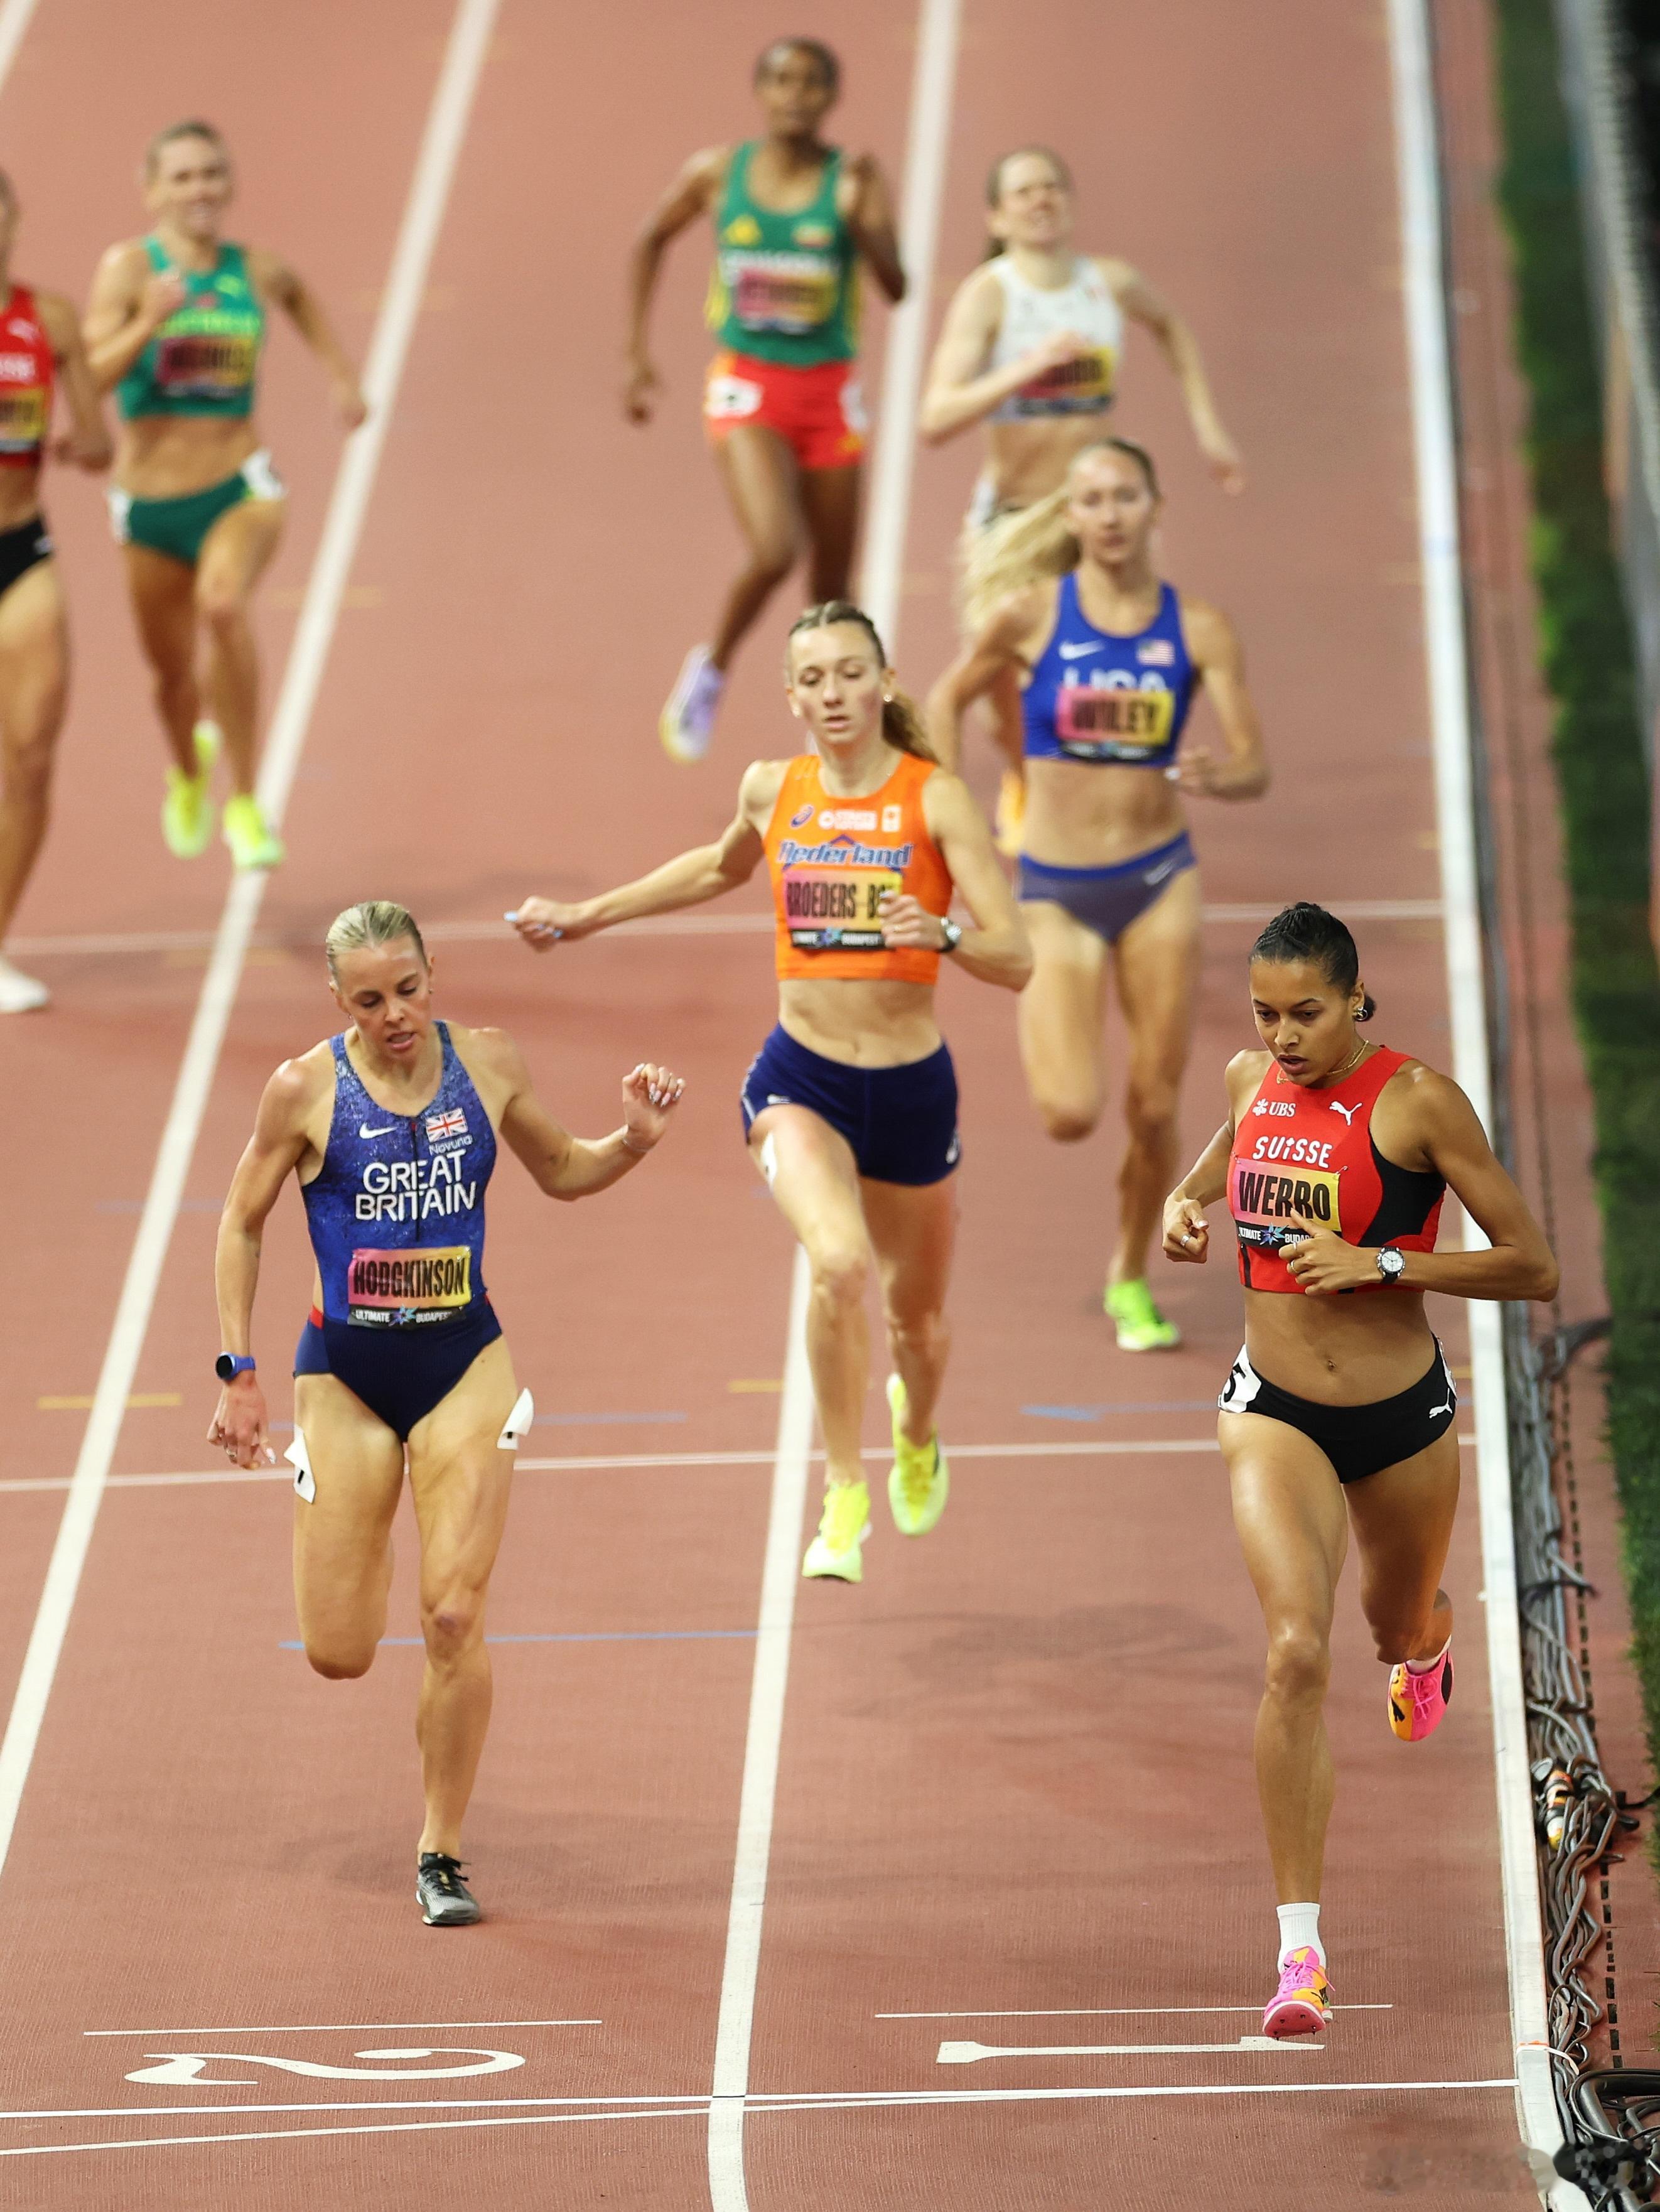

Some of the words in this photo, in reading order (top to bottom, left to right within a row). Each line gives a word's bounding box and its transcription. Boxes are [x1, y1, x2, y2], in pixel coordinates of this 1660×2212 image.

[1269, 1101, 1296, 1117] UBS
[429, 1134, 473, 1156] Novuna
[362, 1149, 466, 1194] GREAT
[355, 1181, 477, 1222] BRITAIN
[1239, 1171, 1331, 1221] WERRO
[353, 1257, 465, 1298] HODGKINSON
